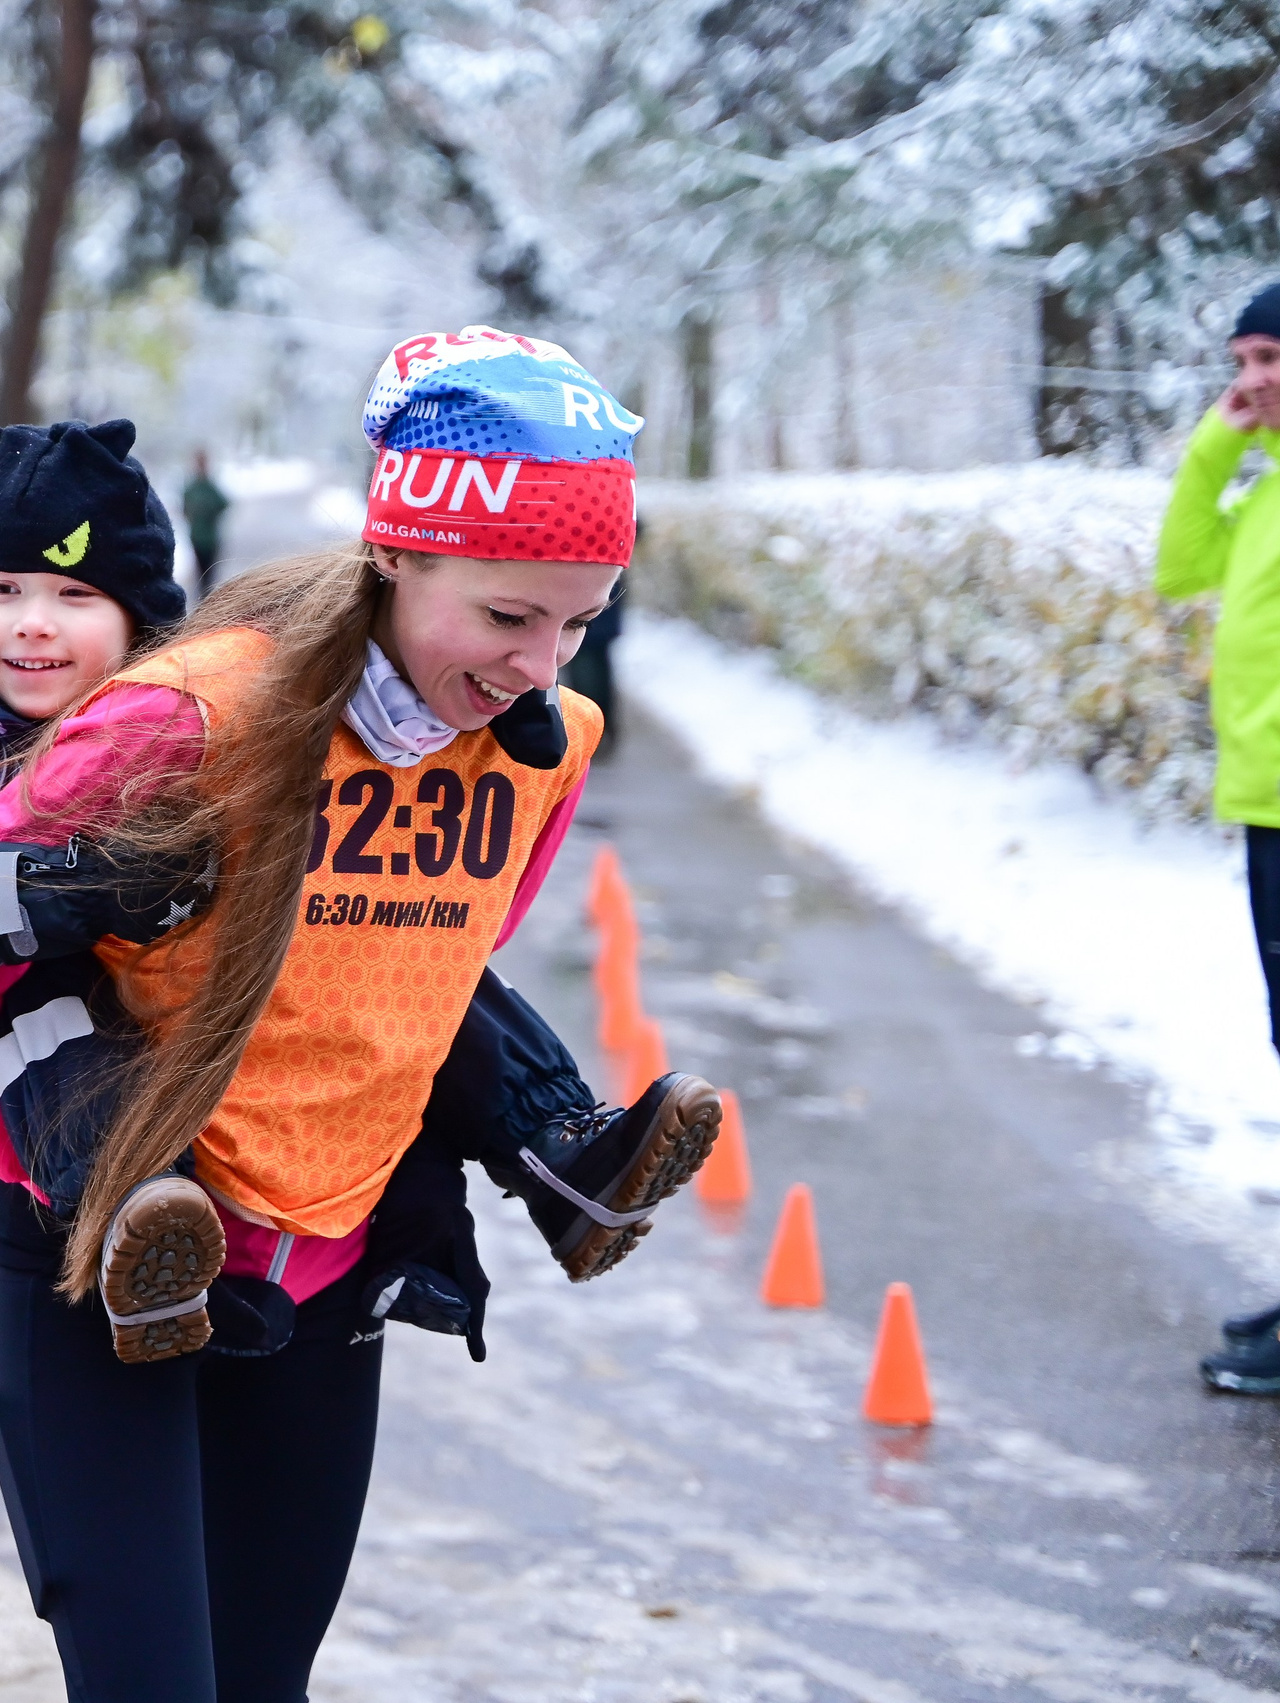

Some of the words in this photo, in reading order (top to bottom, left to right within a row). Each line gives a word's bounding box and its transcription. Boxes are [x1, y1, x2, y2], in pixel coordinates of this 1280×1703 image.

[562, 382, 645, 435] RU
[372, 449, 522, 513] RUN
[305, 894, 368, 925] 6:30
